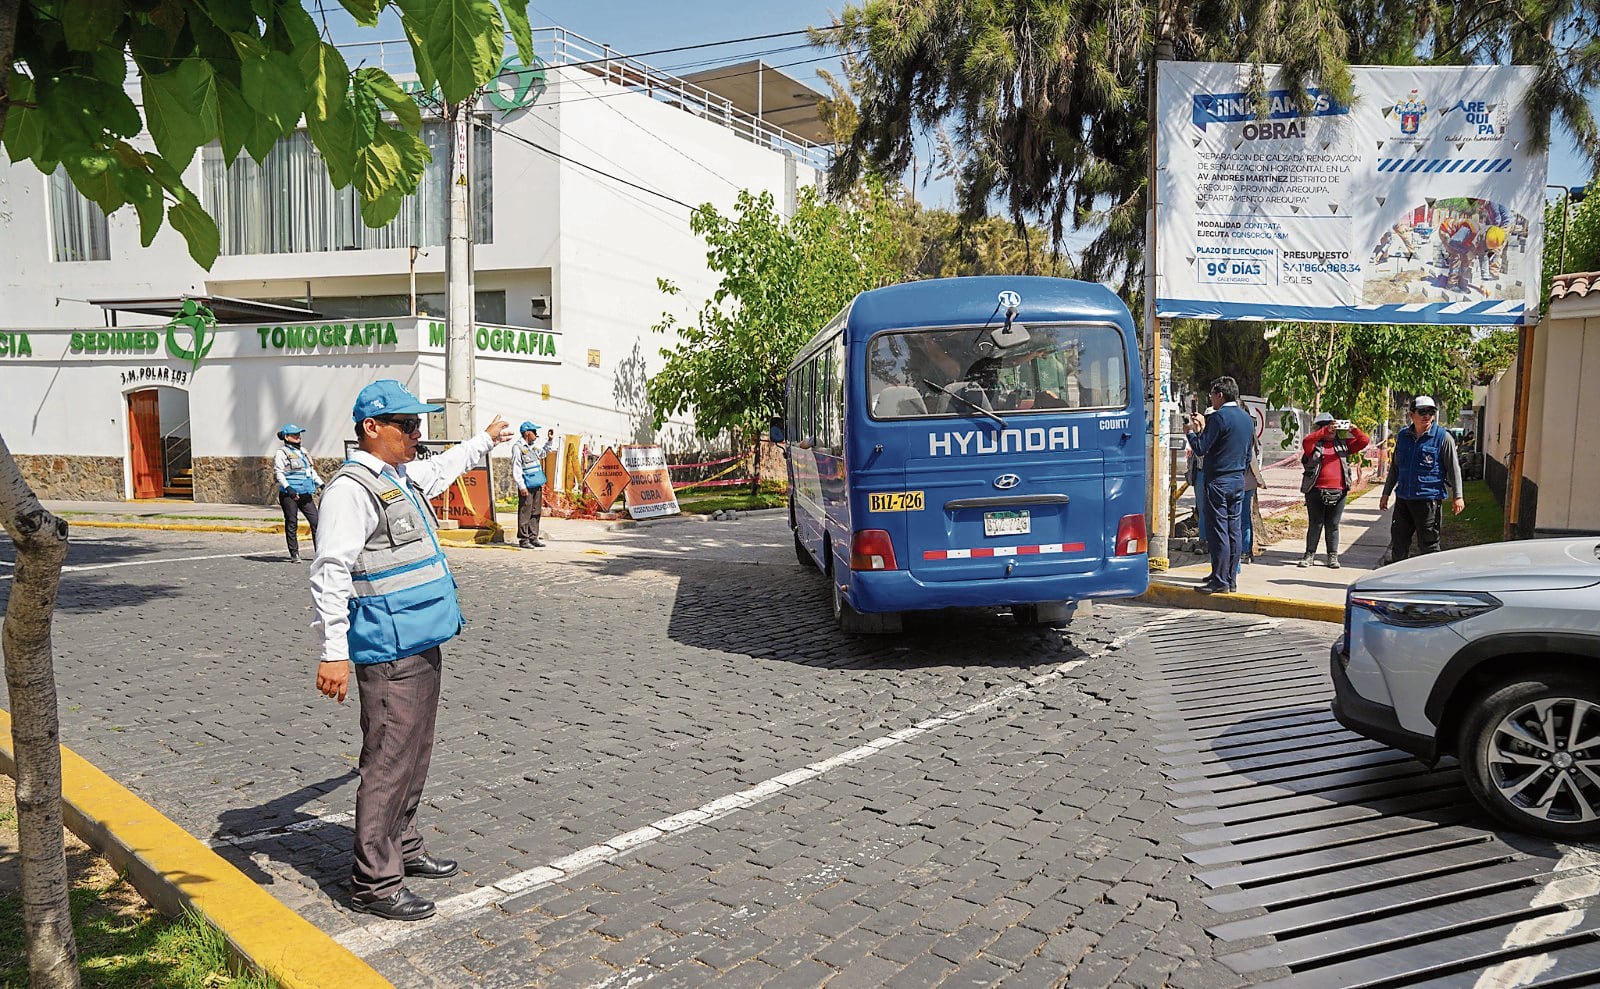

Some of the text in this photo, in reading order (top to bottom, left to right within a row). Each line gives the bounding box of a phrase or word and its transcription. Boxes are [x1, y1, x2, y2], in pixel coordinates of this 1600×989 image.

[1243, 121, 1306, 141] OBRA!
[1478, 124, 1494, 134] PA
[1254, 153, 1264, 162] DE
[1198, 163, 1208, 171] DE
[1271, 164, 1324, 172] HORIZONTAL
[1326, 165, 1338, 173] EN
[1339, 165, 1351, 173] LA
[1290, 175, 1327, 183] DISTRITO
[1328, 175, 1340, 183] DE
[1241, 185, 1285, 193] PROVINCIA
[1197, 193, 1263, 203] DEPARTAMENTO
[1197, 221, 1281, 230] MODALIDAD CONTRATA
[1197, 230, 1229, 238] EJECUTA
[1231, 231, 1272, 239] CONSORCIO
[1196, 246, 1220, 254] PLAZO
[1221, 247, 1231, 255] DE
[1283, 250, 1349, 260] PRESUPUESTO
[1207, 261, 1261, 276] 90 DÍAS
[1283, 275, 1313, 285] SOLES
[256, 322, 399, 349] TOMOGRAFIA
[71, 331, 159, 351] SEDIMED
[1099, 418, 1130, 431] COUNTY
[929, 426, 1079, 456] HYUNDAI
[654, 473, 662, 484] DE
[640, 489, 662, 501] OBRA
[872, 493, 922, 511] B1Z-726
